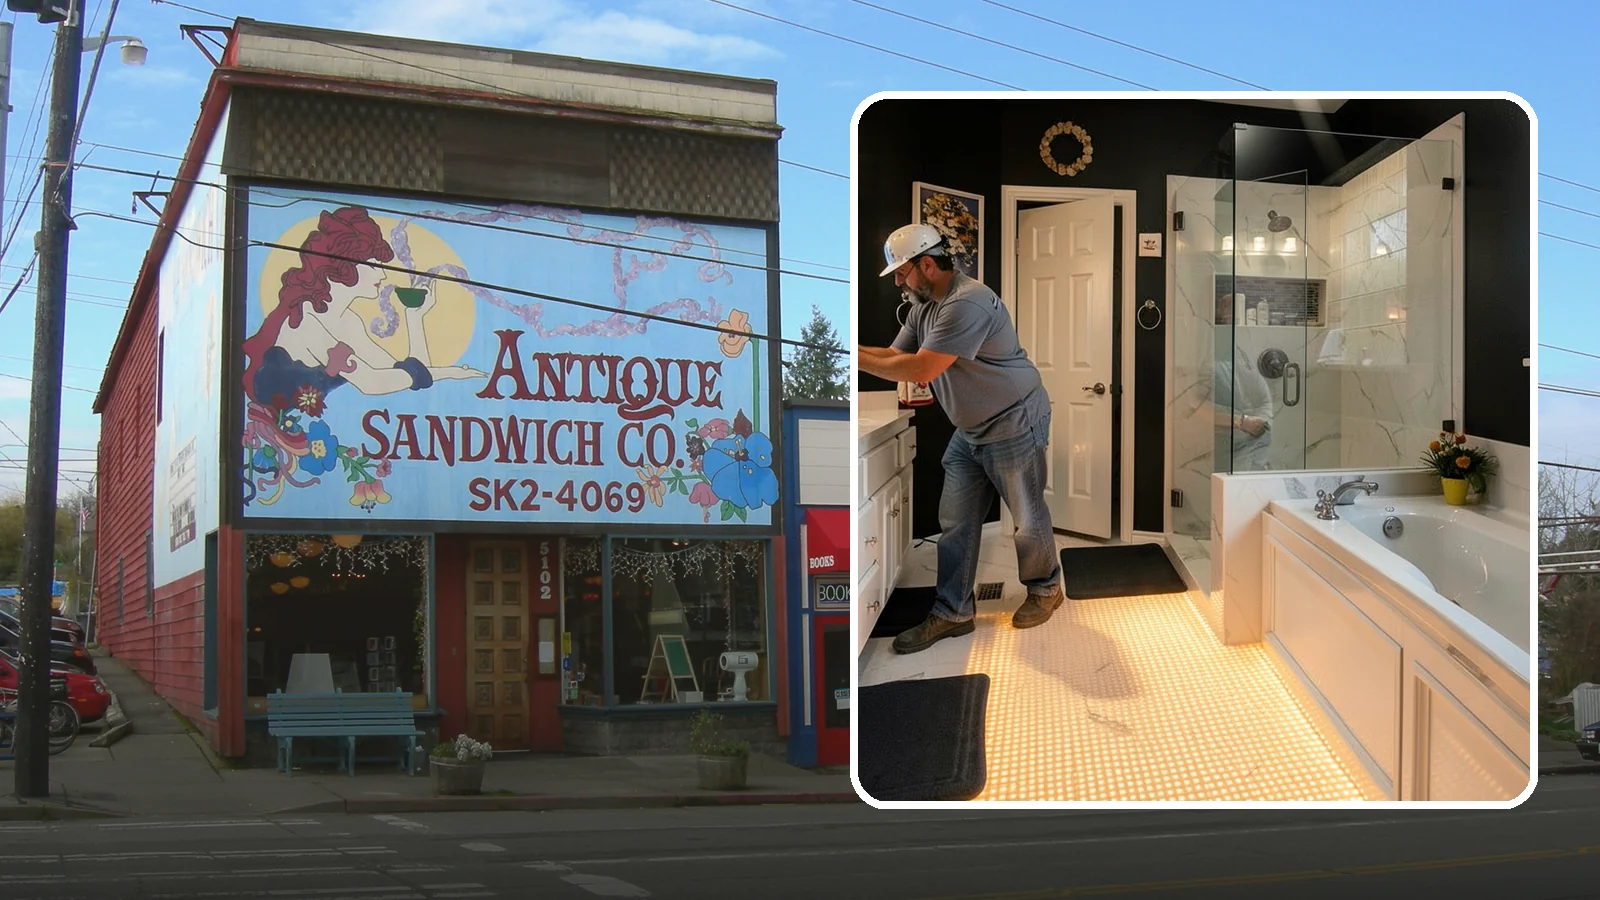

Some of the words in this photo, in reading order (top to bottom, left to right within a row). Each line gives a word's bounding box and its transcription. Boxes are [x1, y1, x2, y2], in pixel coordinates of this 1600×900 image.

[475, 329, 723, 420] ANTIQUE
[361, 408, 604, 467] SANDWICH
[617, 421, 685, 468] CO.
[468, 478, 645, 513] SK2-4069
[539, 541, 552, 600] 5102
[809, 555, 835, 569] BOOKS
